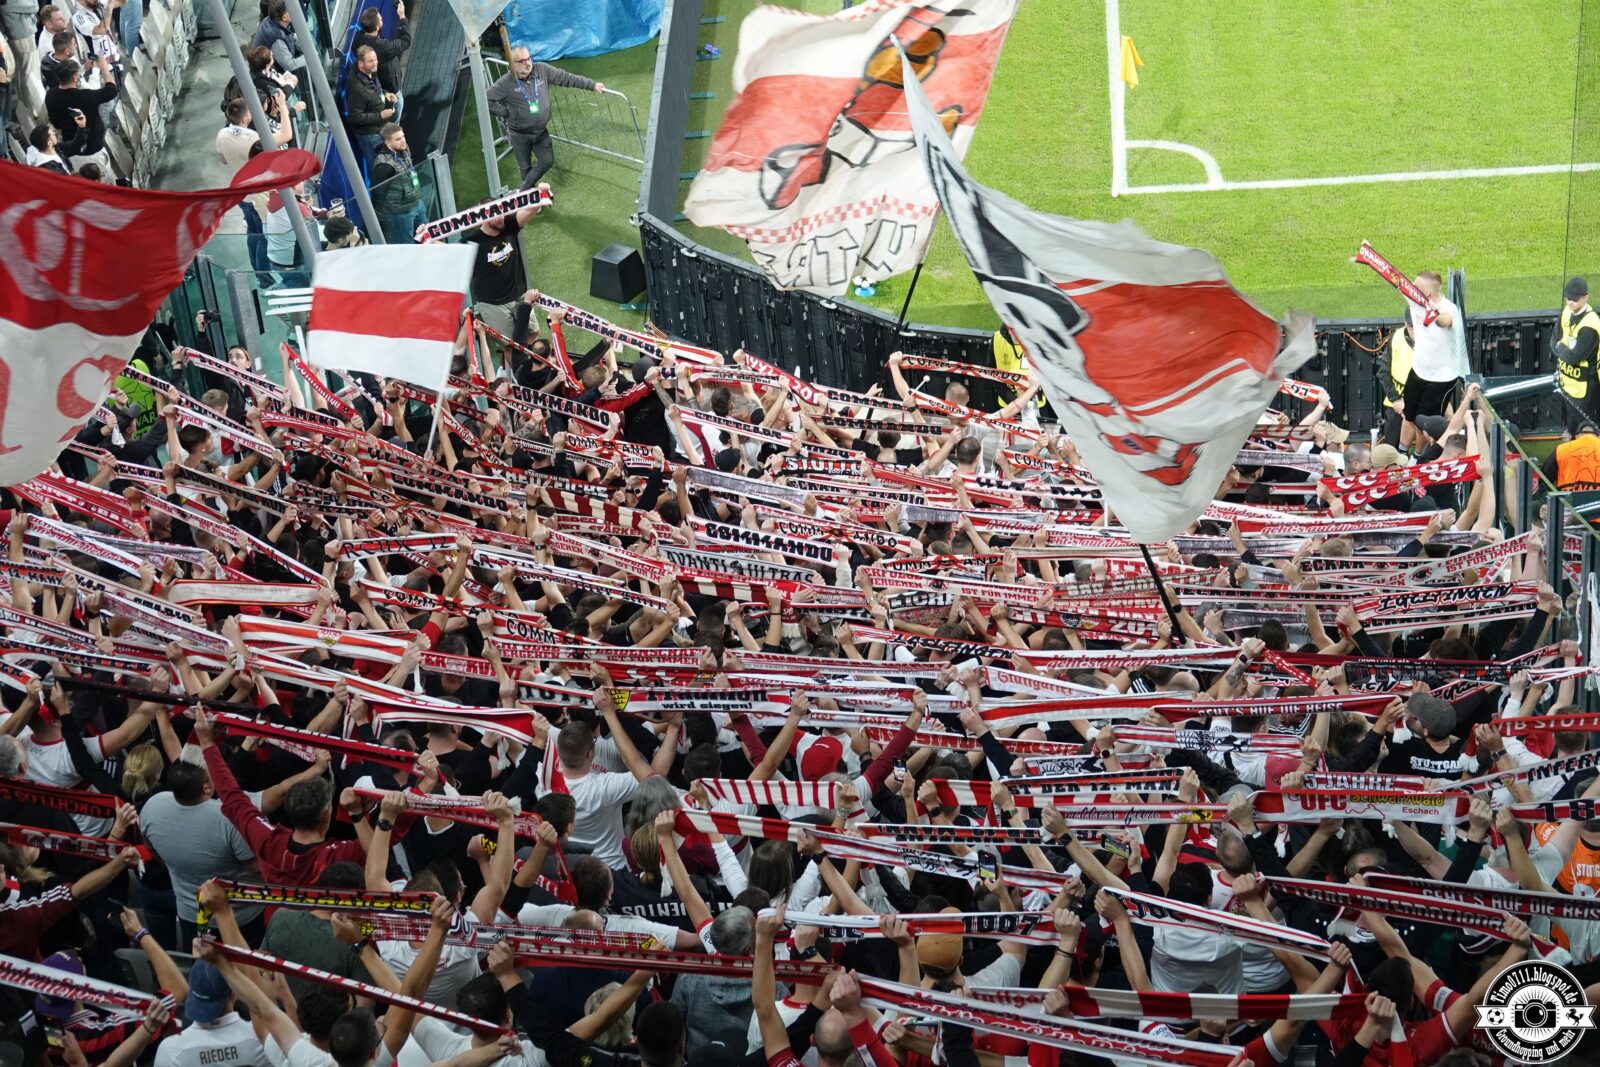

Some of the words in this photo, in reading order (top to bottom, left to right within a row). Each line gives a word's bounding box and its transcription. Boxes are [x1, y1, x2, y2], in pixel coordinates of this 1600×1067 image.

[428, 190, 540, 238] COMMANDO
[563, 312, 664, 359] COMMANDO
[512, 385, 610, 426] COMMANDO
[568, 435, 597, 449] OMM
[1336, 473, 1377, 490] CC
[1348, 487, 1388, 505] CC
[1428, 463, 1469, 482] 97
[705, 523, 833, 562] COMMANDO
[667, 551, 726, 573] AVANTI
[748, 563, 814, 583] ULTRAS
[1302, 559, 1364, 572] ECKAR
[507, 618, 555, 645] COMM
[502, 649, 560, 659] ERGEHEN
[662, 702, 698, 710] wird
[699, 702, 752, 712] siegen!
[1040, 782, 1081, 793] DER
[1089, 781, 1118, 792] 12.
[1325, 774, 1397, 791] JAHRE
[1402, 806, 1440, 816] Eschach
[200, 1046, 238, 1064] RIEDER
